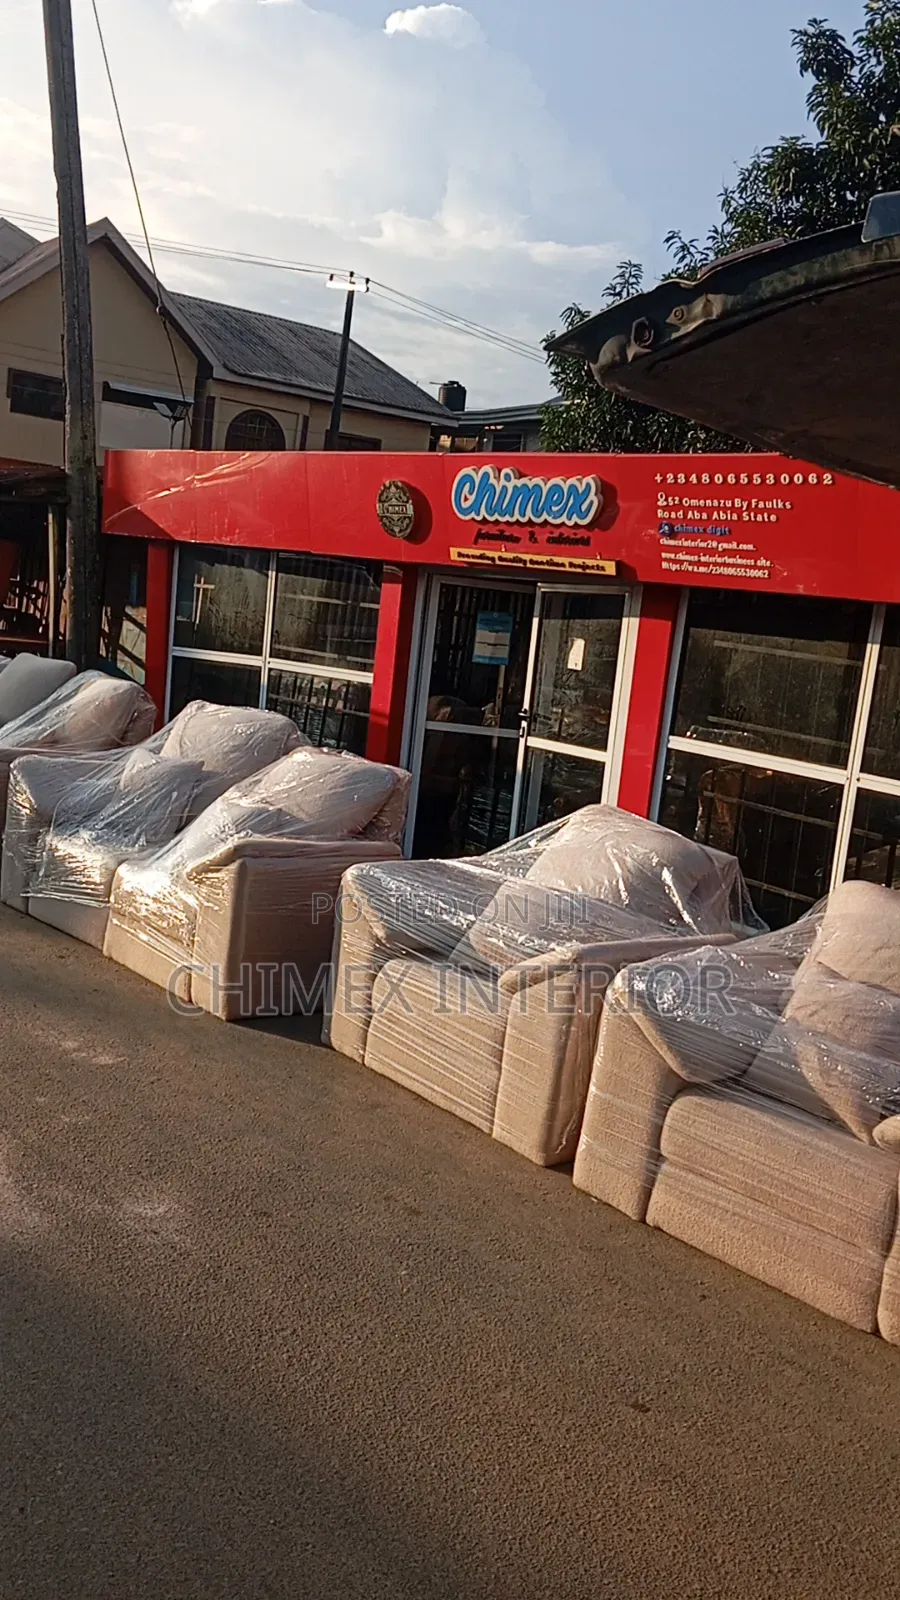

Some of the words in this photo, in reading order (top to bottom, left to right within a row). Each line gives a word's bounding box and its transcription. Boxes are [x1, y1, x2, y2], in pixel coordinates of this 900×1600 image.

[453, 467, 599, 524] Chimex
[668, 496, 680, 505] 52
[683, 497, 732, 508] Omenazu
[734, 498, 748, 511] By
[752, 498, 792, 509] Faulks
[657, 509, 684, 519] Road
[687, 510, 708, 520] Aba
[712, 510, 738, 521] Abia
[742, 511, 778, 522] State
[528, 529, 539, 544] &
